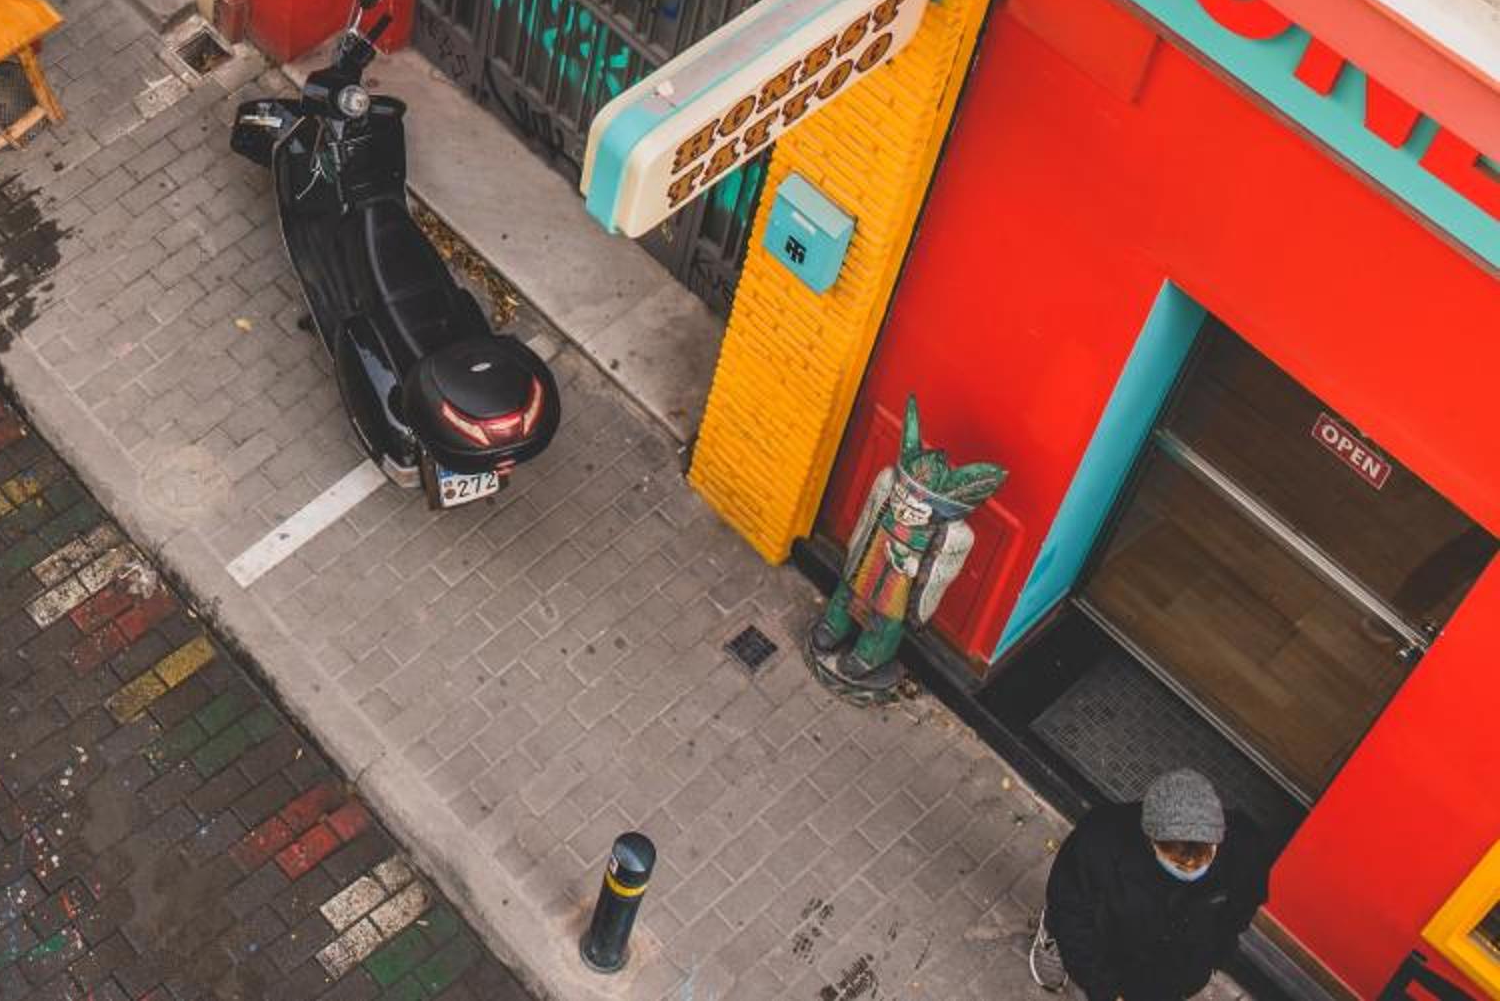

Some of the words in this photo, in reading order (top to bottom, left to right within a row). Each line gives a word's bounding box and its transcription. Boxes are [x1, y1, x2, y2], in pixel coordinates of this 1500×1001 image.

[667, 32, 893, 209] TATTOO
[1321, 424, 1381, 480] OPEN
[457, 471, 497, 498] 272
